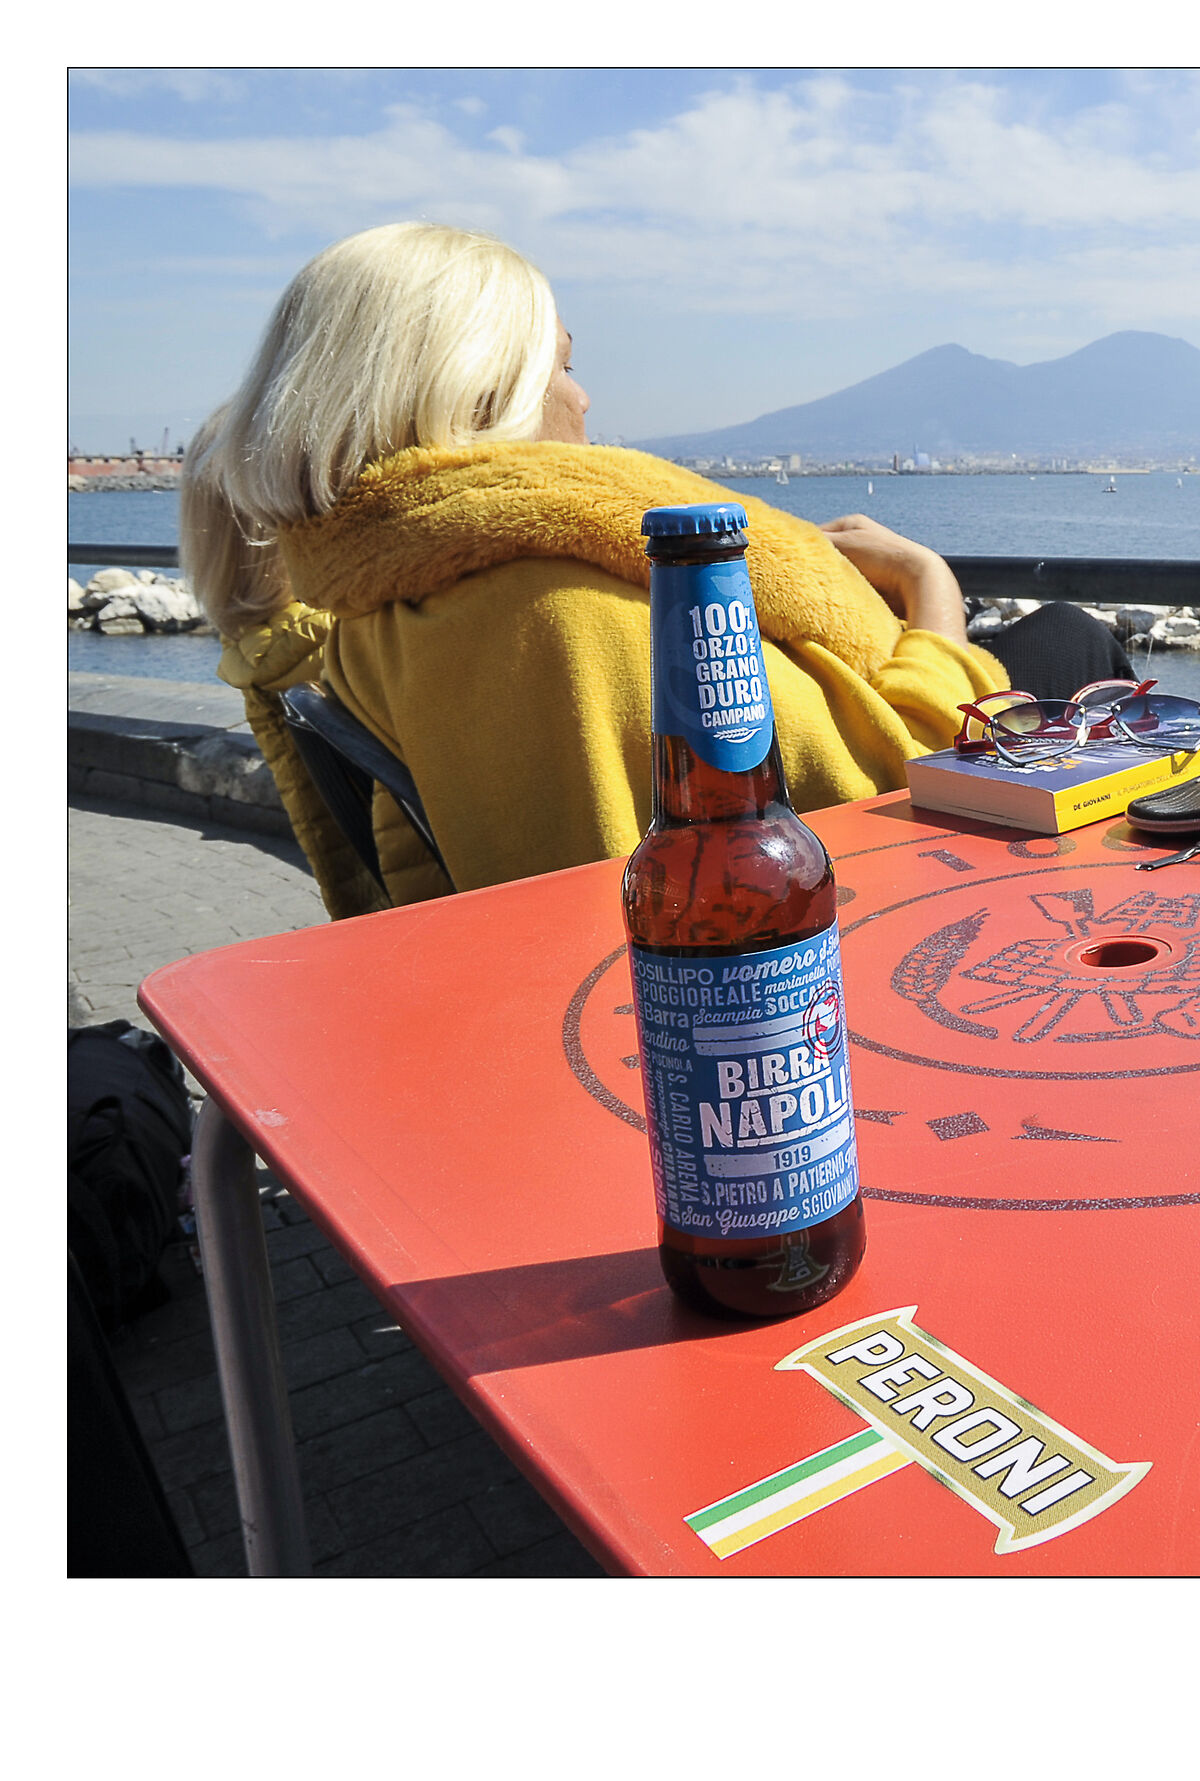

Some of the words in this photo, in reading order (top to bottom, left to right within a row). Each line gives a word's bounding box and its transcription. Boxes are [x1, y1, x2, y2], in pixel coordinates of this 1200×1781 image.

[693, 634, 748, 660] ORZO
[750, 638, 756, 654] E
[696, 656, 759, 683] GRANO
[698, 677, 763, 709] DURO
[701, 704, 766, 728] CAMPANO
[1083, 794, 1111, 807] GIOVANNI
[632, 957, 714, 985] POSILLIPO
[642, 981, 762, 1007] POGGIOREALE
[764, 965, 826, 995] marianella
[644, 1002, 689, 1028] Barra
[693, 1006, 763, 1027] Scampia
[667, 1072, 687, 1086] S.
[717, 1039, 830, 1099] BIRRA
[669, 1092, 694, 1144] CARLO
[698, 1065, 847, 1148] NAPOLI
[773, 1145, 811, 1170] 1919
[676, 1147, 700, 1202] ARENA
[773, 1178, 784, 1201] A
[788, 1151, 845, 1198] PATIERNO
[681, 1206, 713, 1228] San
[715, 1205, 801, 1235] Giuseppe
[825, 1330, 1095, 1516] PERONI
